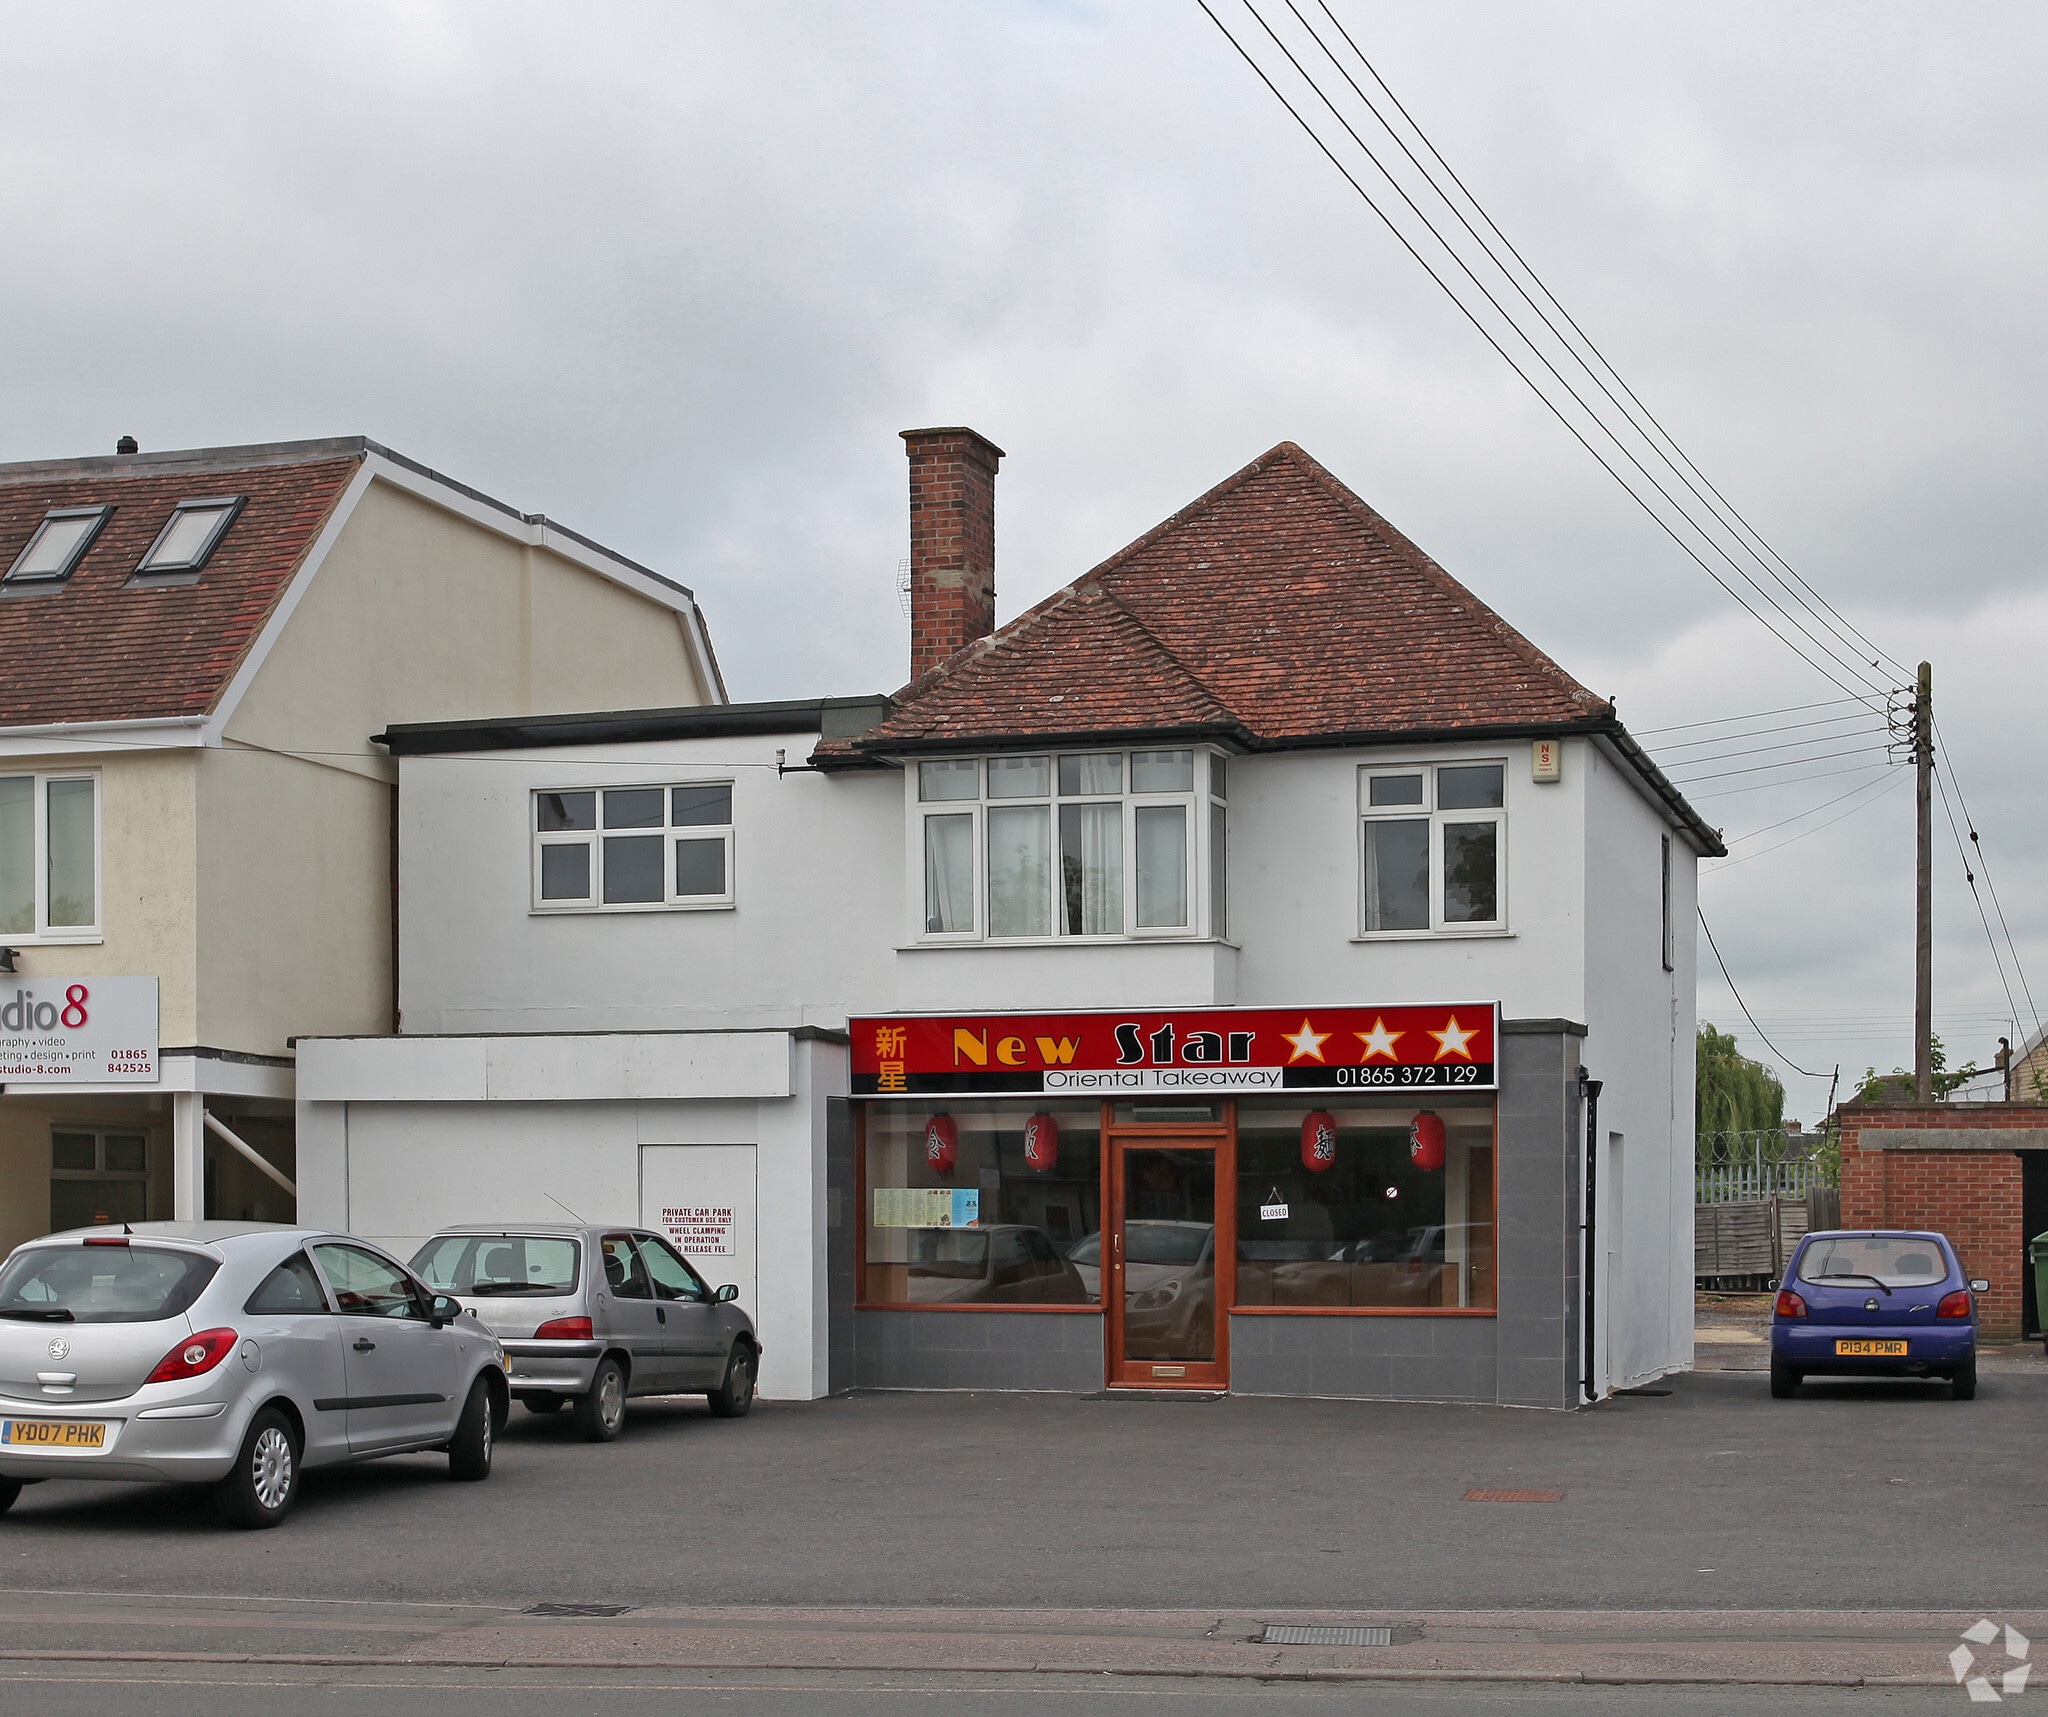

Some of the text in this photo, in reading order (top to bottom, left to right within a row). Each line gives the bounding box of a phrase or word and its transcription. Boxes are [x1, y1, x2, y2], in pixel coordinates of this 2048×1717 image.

[0, 984, 88, 1031] dio 8
[0, 1037, 66, 1048] raphy video
[953, 1022, 1256, 1066] New Star
[30, 1050, 63, 1062] design
[71, 1050, 96, 1061] print
[111, 1050, 147, 1059] 01865
[875, 1026, 907, 1092] 新星
[107, 1063, 151, 1073] 842525
[1046, 1068, 1280, 1088] Oriental Takeaway
[1336, 1065, 1477, 1084] 01865 372 129
[662, 1208, 732, 1217] PRIVATE CAR PARK
[1262, 1208, 1287, 1218] CLOSED
[684, 1236, 720, 1244] OPERATION
[684, 1245, 712, 1253] RELEASE
[714, 1245, 726, 1253] FEE
[1840, 1342, 1902, 1354] P134 PMR
[16, 1423, 101, 1443] YD07 PHK
